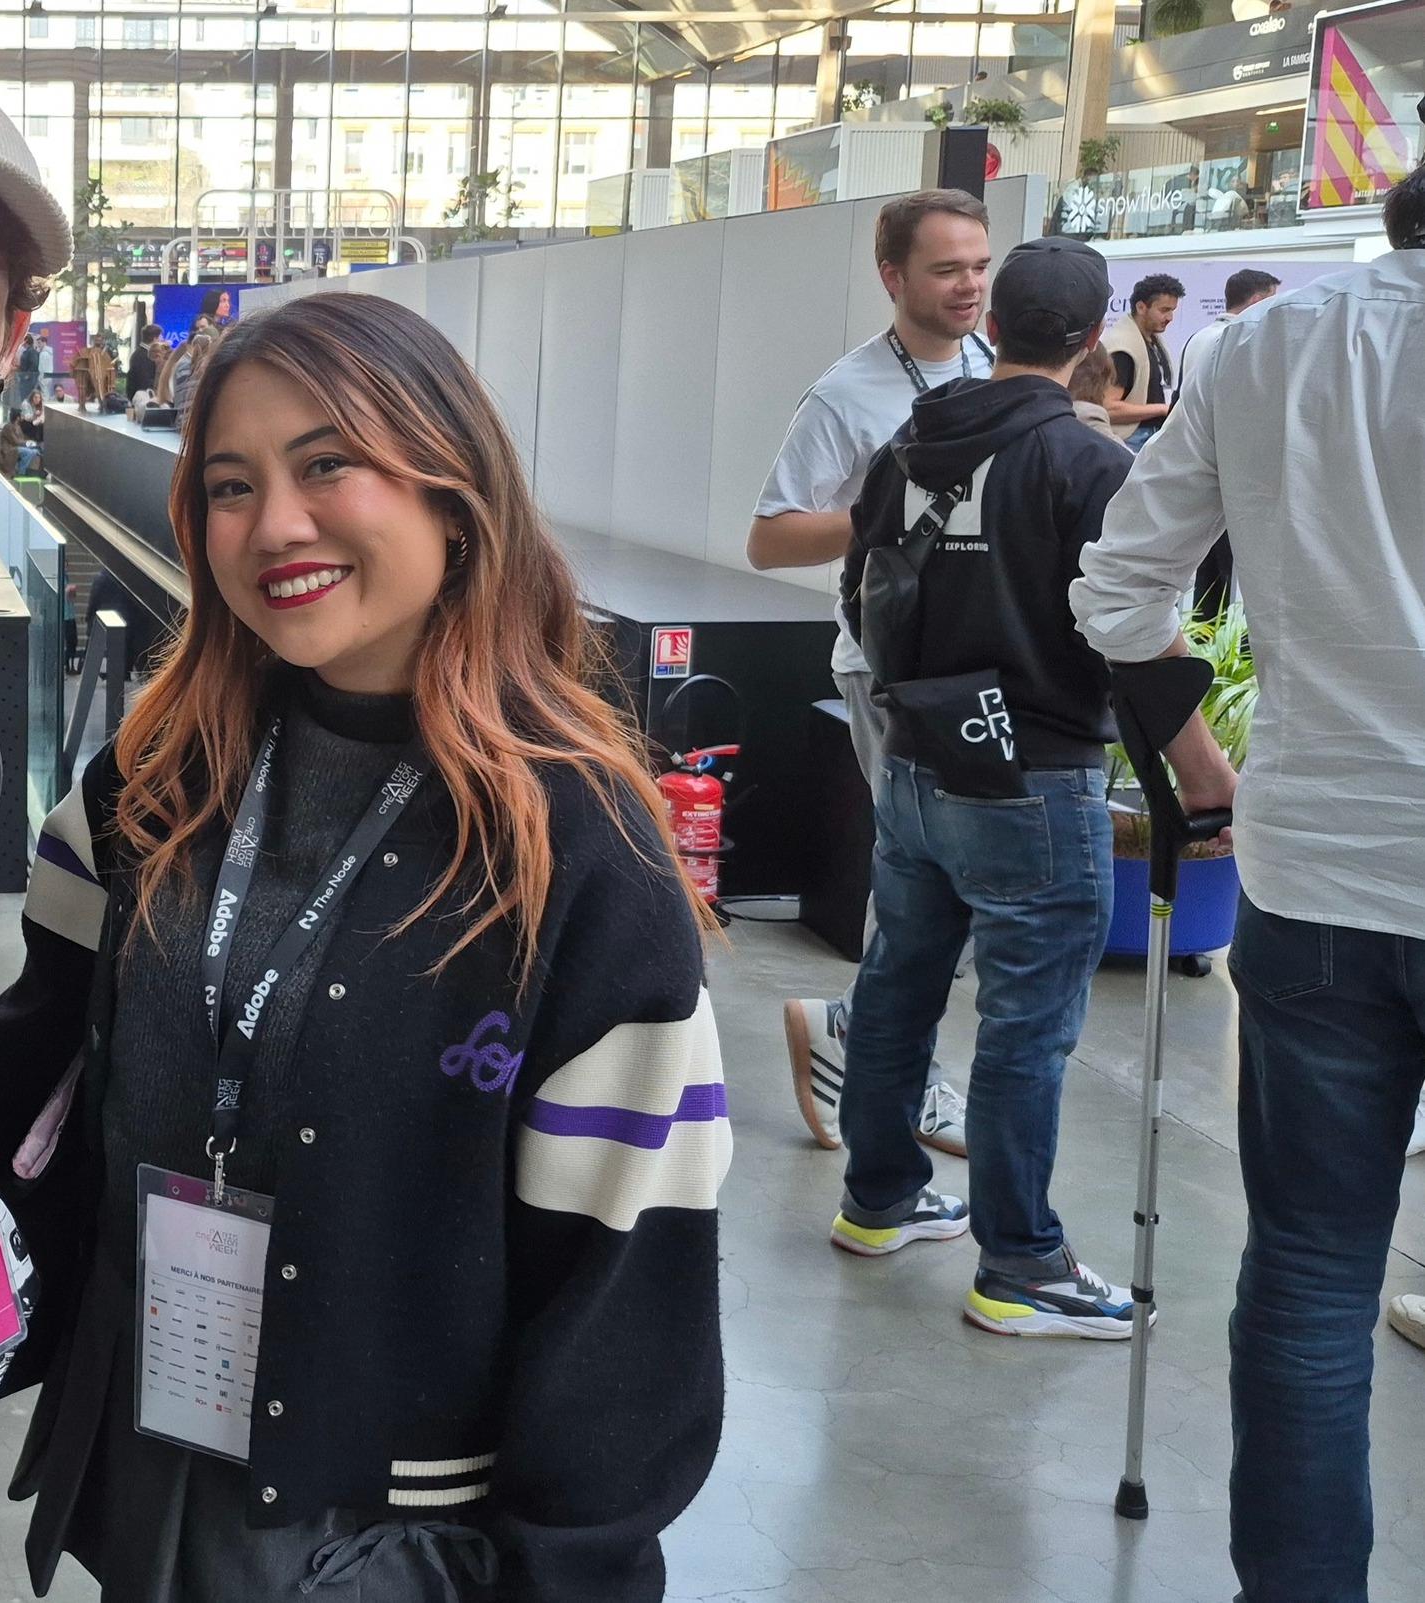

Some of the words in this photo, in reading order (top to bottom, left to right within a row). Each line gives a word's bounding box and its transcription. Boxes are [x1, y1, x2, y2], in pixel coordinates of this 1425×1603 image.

[1097, 184, 1182, 216] snowflake
[255, 760, 272, 793] Node
[313, 887, 335, 909] The
[328, 855, 356, 888] Node
[207, 888, 238, 957] Adobe
[236, 968, 279, 1040] Adobe
[171, 1265, 193, 1277] MERCI
[194, 1271, 199, 1279] À
[200, 1274, 215, 1283] NOS
